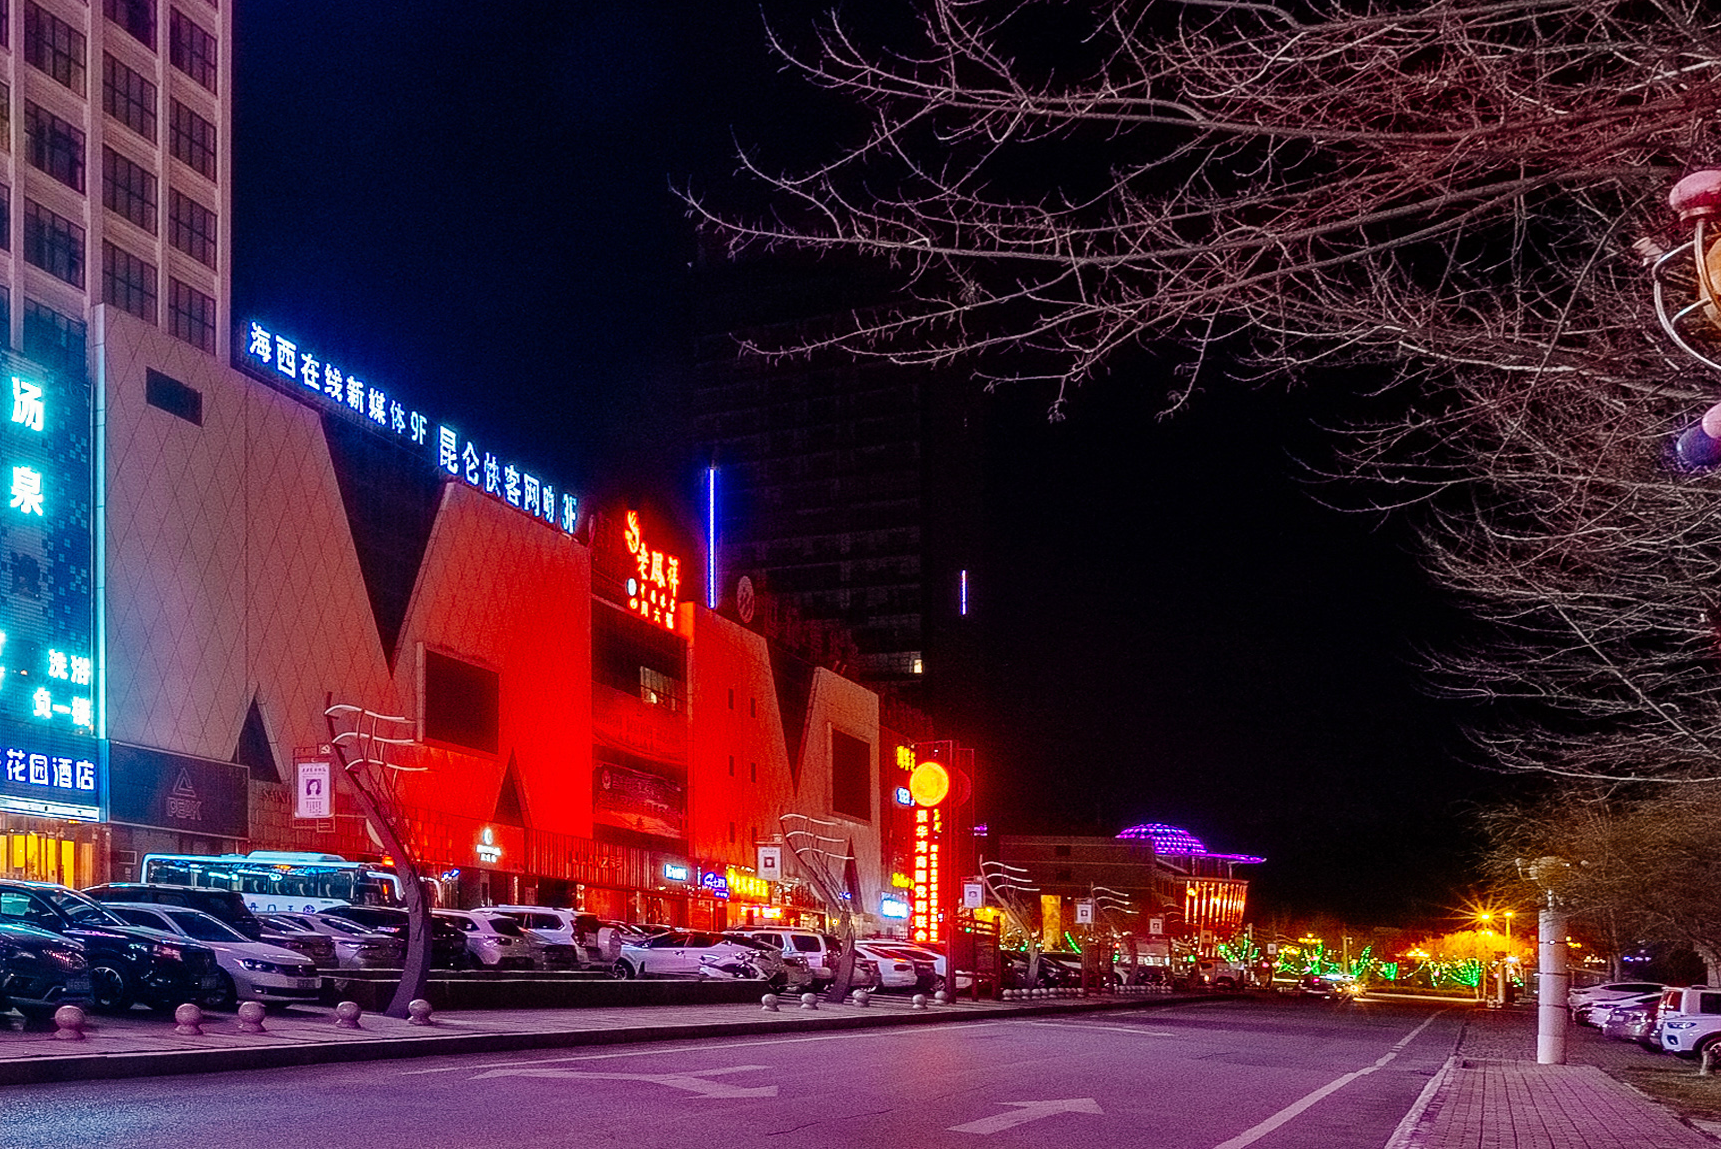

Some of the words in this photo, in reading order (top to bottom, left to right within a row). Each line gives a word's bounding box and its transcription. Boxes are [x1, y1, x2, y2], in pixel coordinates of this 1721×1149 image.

[250, 322, 407, 435] 海西在线新媒体
